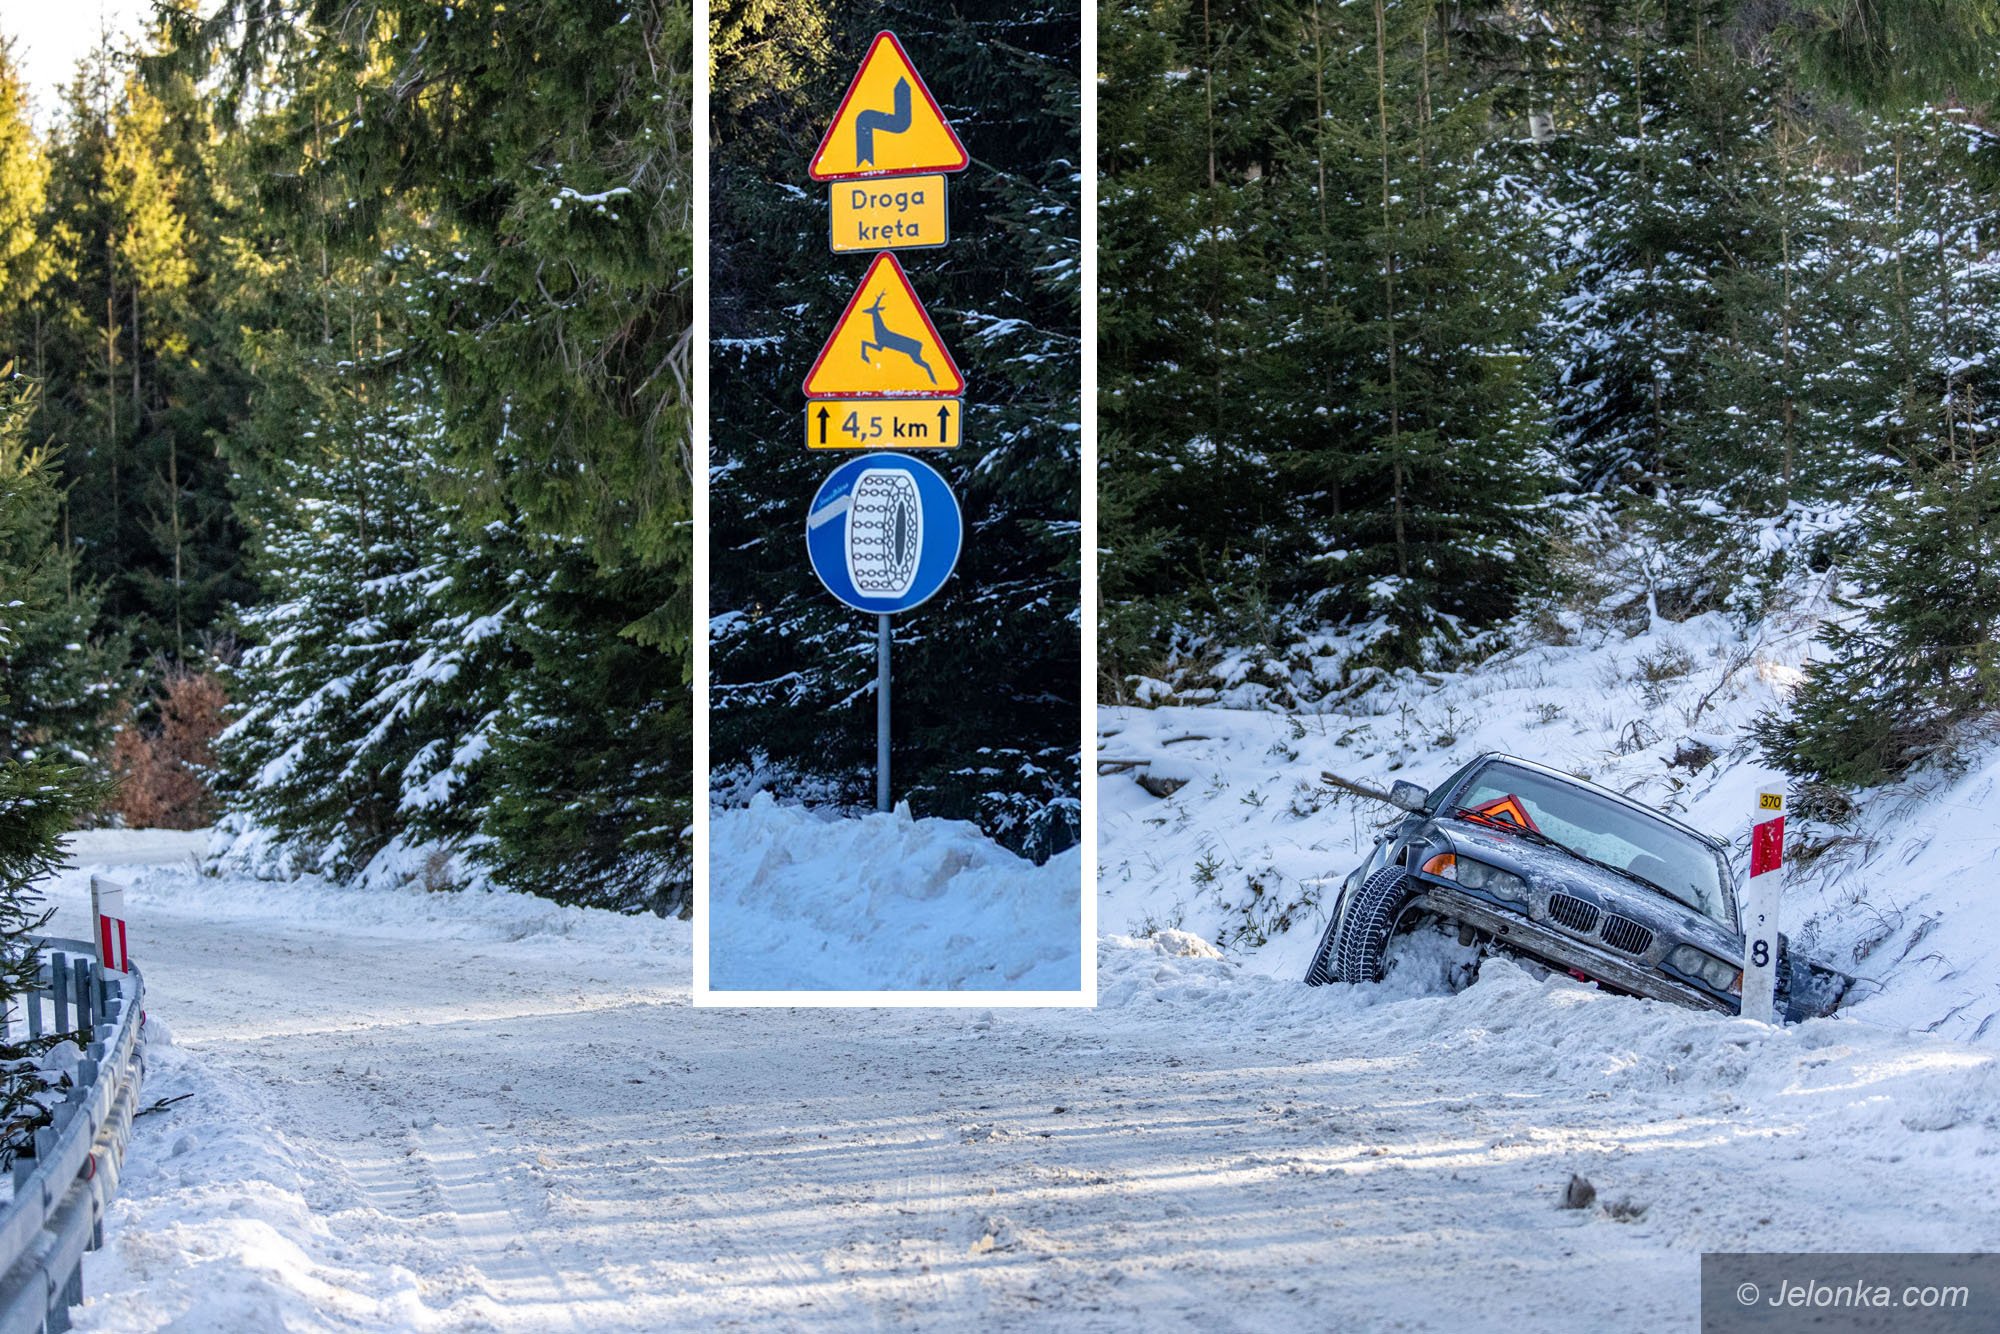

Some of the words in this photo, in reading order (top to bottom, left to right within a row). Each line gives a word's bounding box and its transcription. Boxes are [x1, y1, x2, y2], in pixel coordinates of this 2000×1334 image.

[852, 189, 925, 213] Droga
[858, 218, 919, 245] kręta
[842, 411, 882, 441] 4,5
[893, 417, 928, 438] km
[1761, 795, 1781, 808] 370
[1751, 939, 1769, 968] 8
